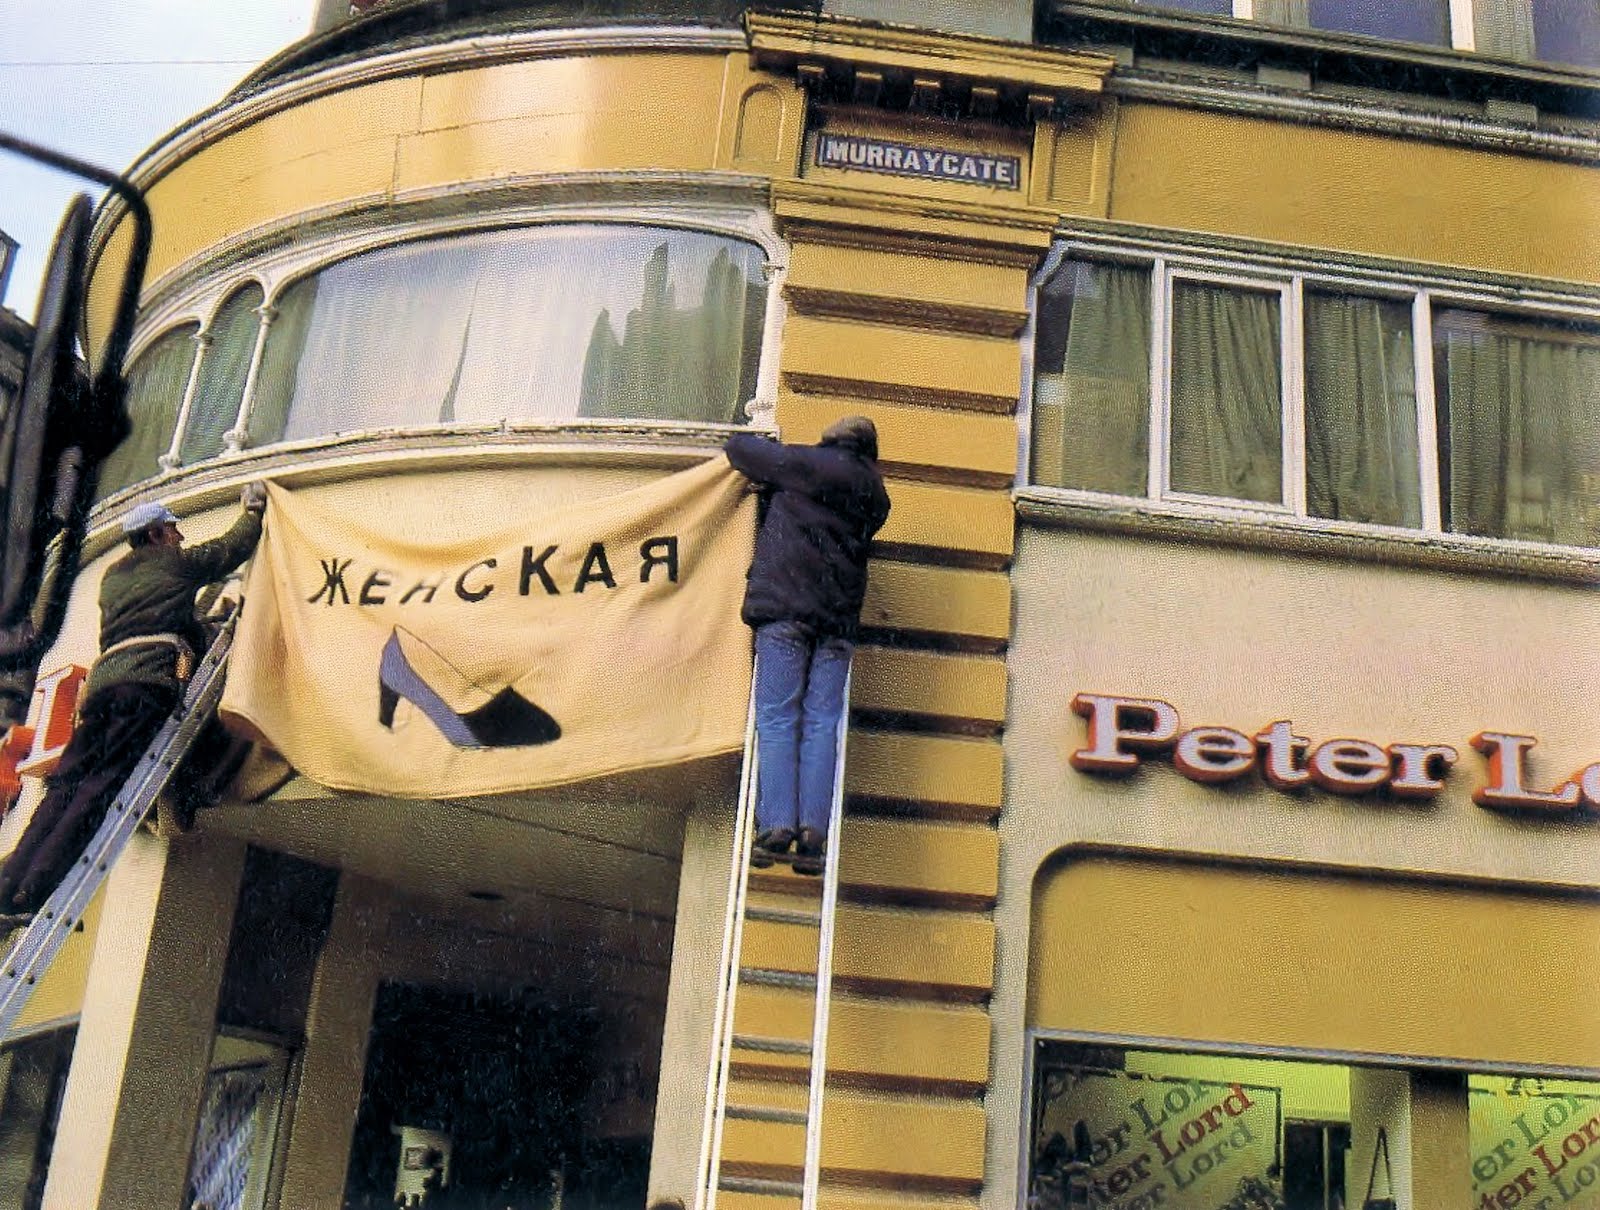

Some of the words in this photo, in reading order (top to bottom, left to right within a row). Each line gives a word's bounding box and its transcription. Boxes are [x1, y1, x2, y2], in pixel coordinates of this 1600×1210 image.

[308, 535, 679, 606] ЖЕНСКАЯ
[1069, 692, 1459, 800] Peter
[1151, 1083, 1255, 1165] Lord
[1164, 1119, 1254, 1190] Lord
